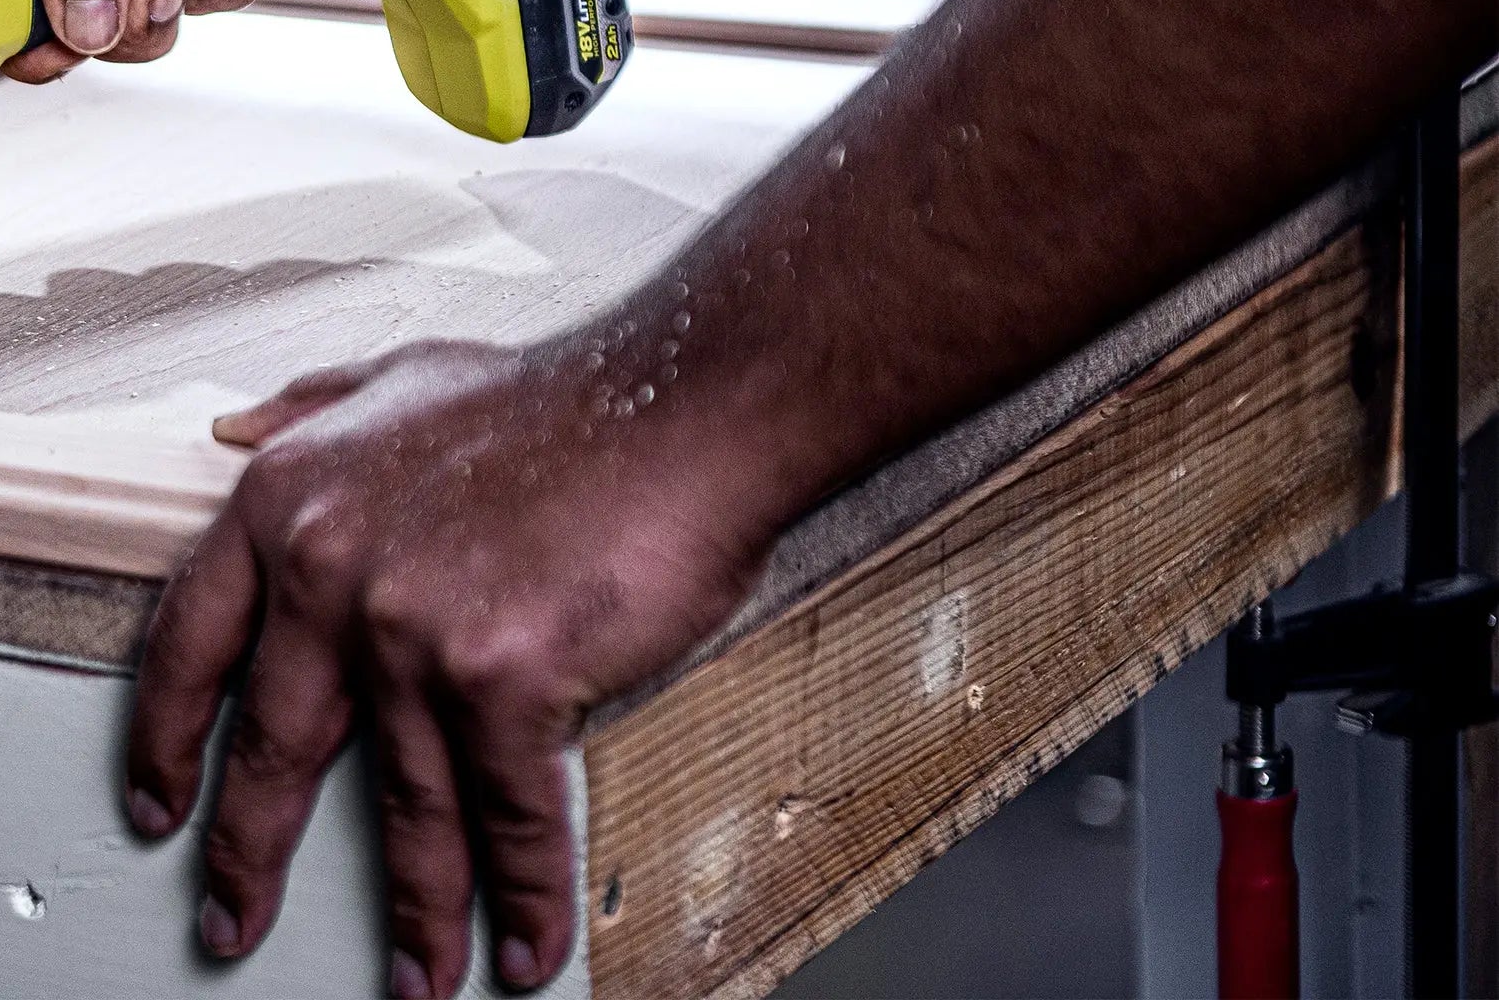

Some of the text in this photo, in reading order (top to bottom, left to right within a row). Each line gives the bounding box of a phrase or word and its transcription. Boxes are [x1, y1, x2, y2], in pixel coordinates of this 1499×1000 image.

[577, 21, 593, 61] 18V
[592, 32, 600, 57] HIGH
[606, 25, 619, 60] 2Ah
